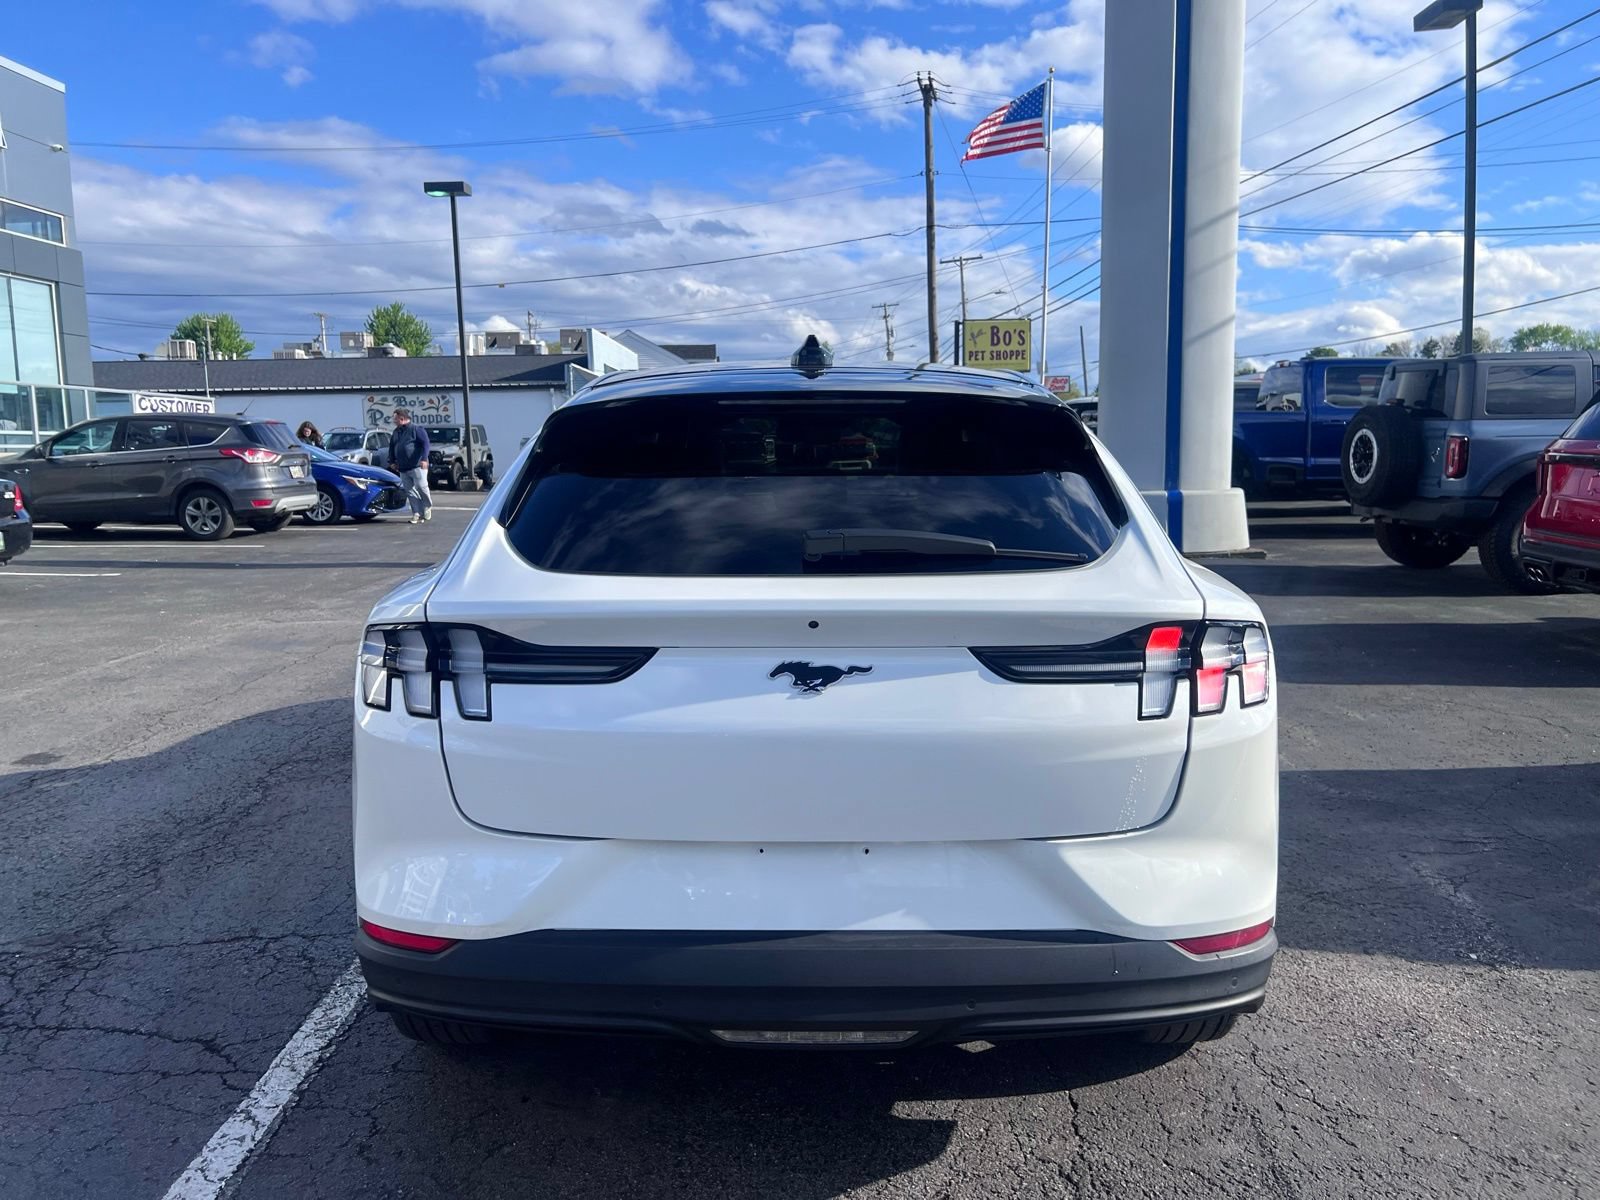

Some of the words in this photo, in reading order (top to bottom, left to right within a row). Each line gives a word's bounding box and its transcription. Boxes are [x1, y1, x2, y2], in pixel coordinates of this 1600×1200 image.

[968, 350, 986, 361] PET
[989, 350, 1026, 361] SHOPPE
[138, 397, 211, 413] CUSTOMER
[392, 395, 426, 407] Bo's
[366, 408, 394, 426] Pe
[409, 409, 452, 425] hoppe
